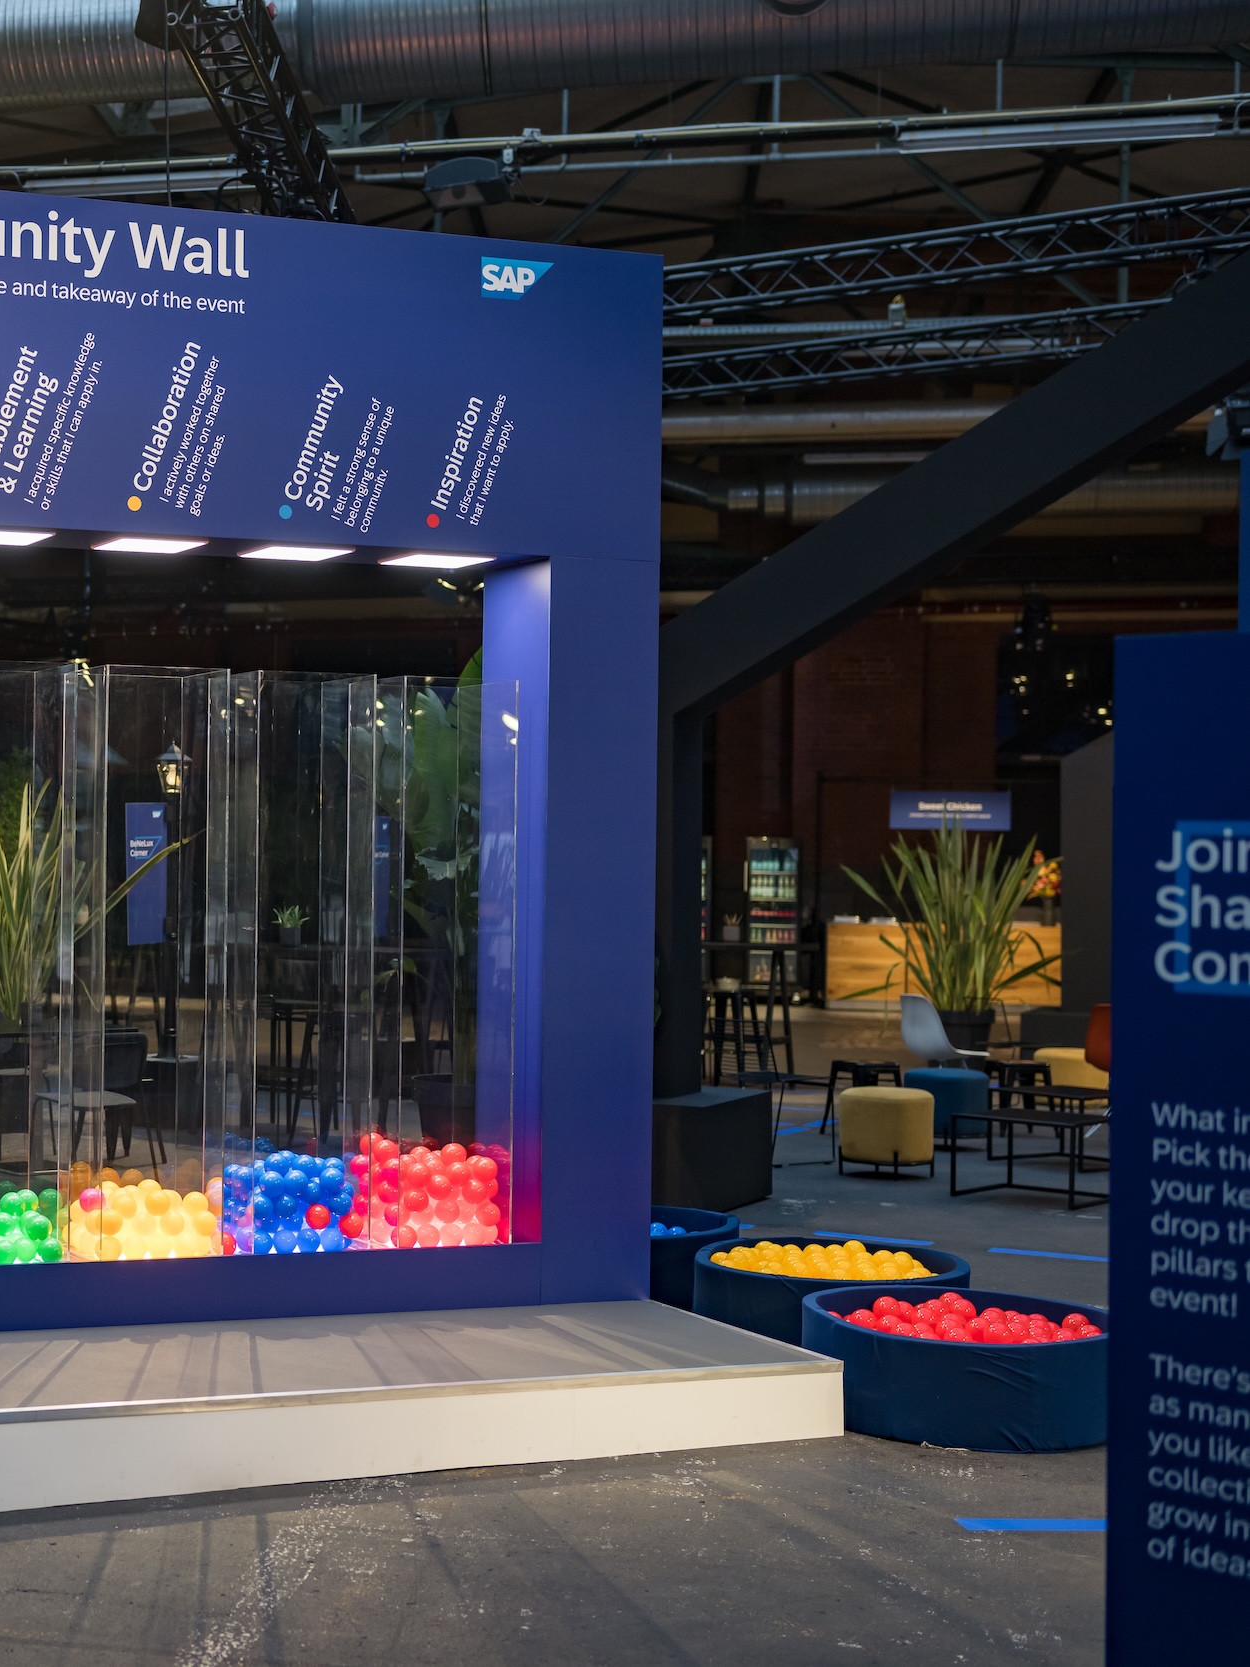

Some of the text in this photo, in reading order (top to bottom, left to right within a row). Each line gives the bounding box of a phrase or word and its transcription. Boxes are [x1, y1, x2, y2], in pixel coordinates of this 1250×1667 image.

[128, 222, 249, 278] Wall
[482, 264, 536, 294] SAP
[12, 280, 47, 297] and
[51, 282, 137, 309] takeaway
[141, 289, 159, 306] of
[162, 291, 192, 309] the
[196, 297, 245, 314] event
[3, 371, 58, 472] Learning
[28, 332, 95, 497] acquired specific knowledge
[40, 360, 102, 510] or skills that can apply in.
[133, 341, 201, 491] Collaboration
[163, 355, 219, 496] actively worked together
[284, 374, 343, 500] Community
[174, 384, 225, 508] with others on shared
[189, 434, 225, 516] goals or ideas.
[332, 396, 381, 514] felt a strong sense of
[343, 405, 394, 527] belonging to a unique
[430, 396, 483, 510] Inspiration
[458, 394, 506, 513] discovered new ideas
[469, 419, 514, 525] that want to apply.
[305, 450, 340, 511] Spirit
[1151, 1102, 1225, 1133] What
[1152, 1138, 1211, 1167] Pick
[1151, 1178, 1215, 1205] your
[1151, 1210, 1220, 1246] drop
[1151, 1246, 1237, 1281] pillars
[1150, 1286, 1238, 1318] event!
[1149, 1394, 1181, 1418] as
[1148, 1430, 1201, 1457] you
[1147, 1501, 1218, 1534] grow
[1147, 1535, 1176, 1561] of
